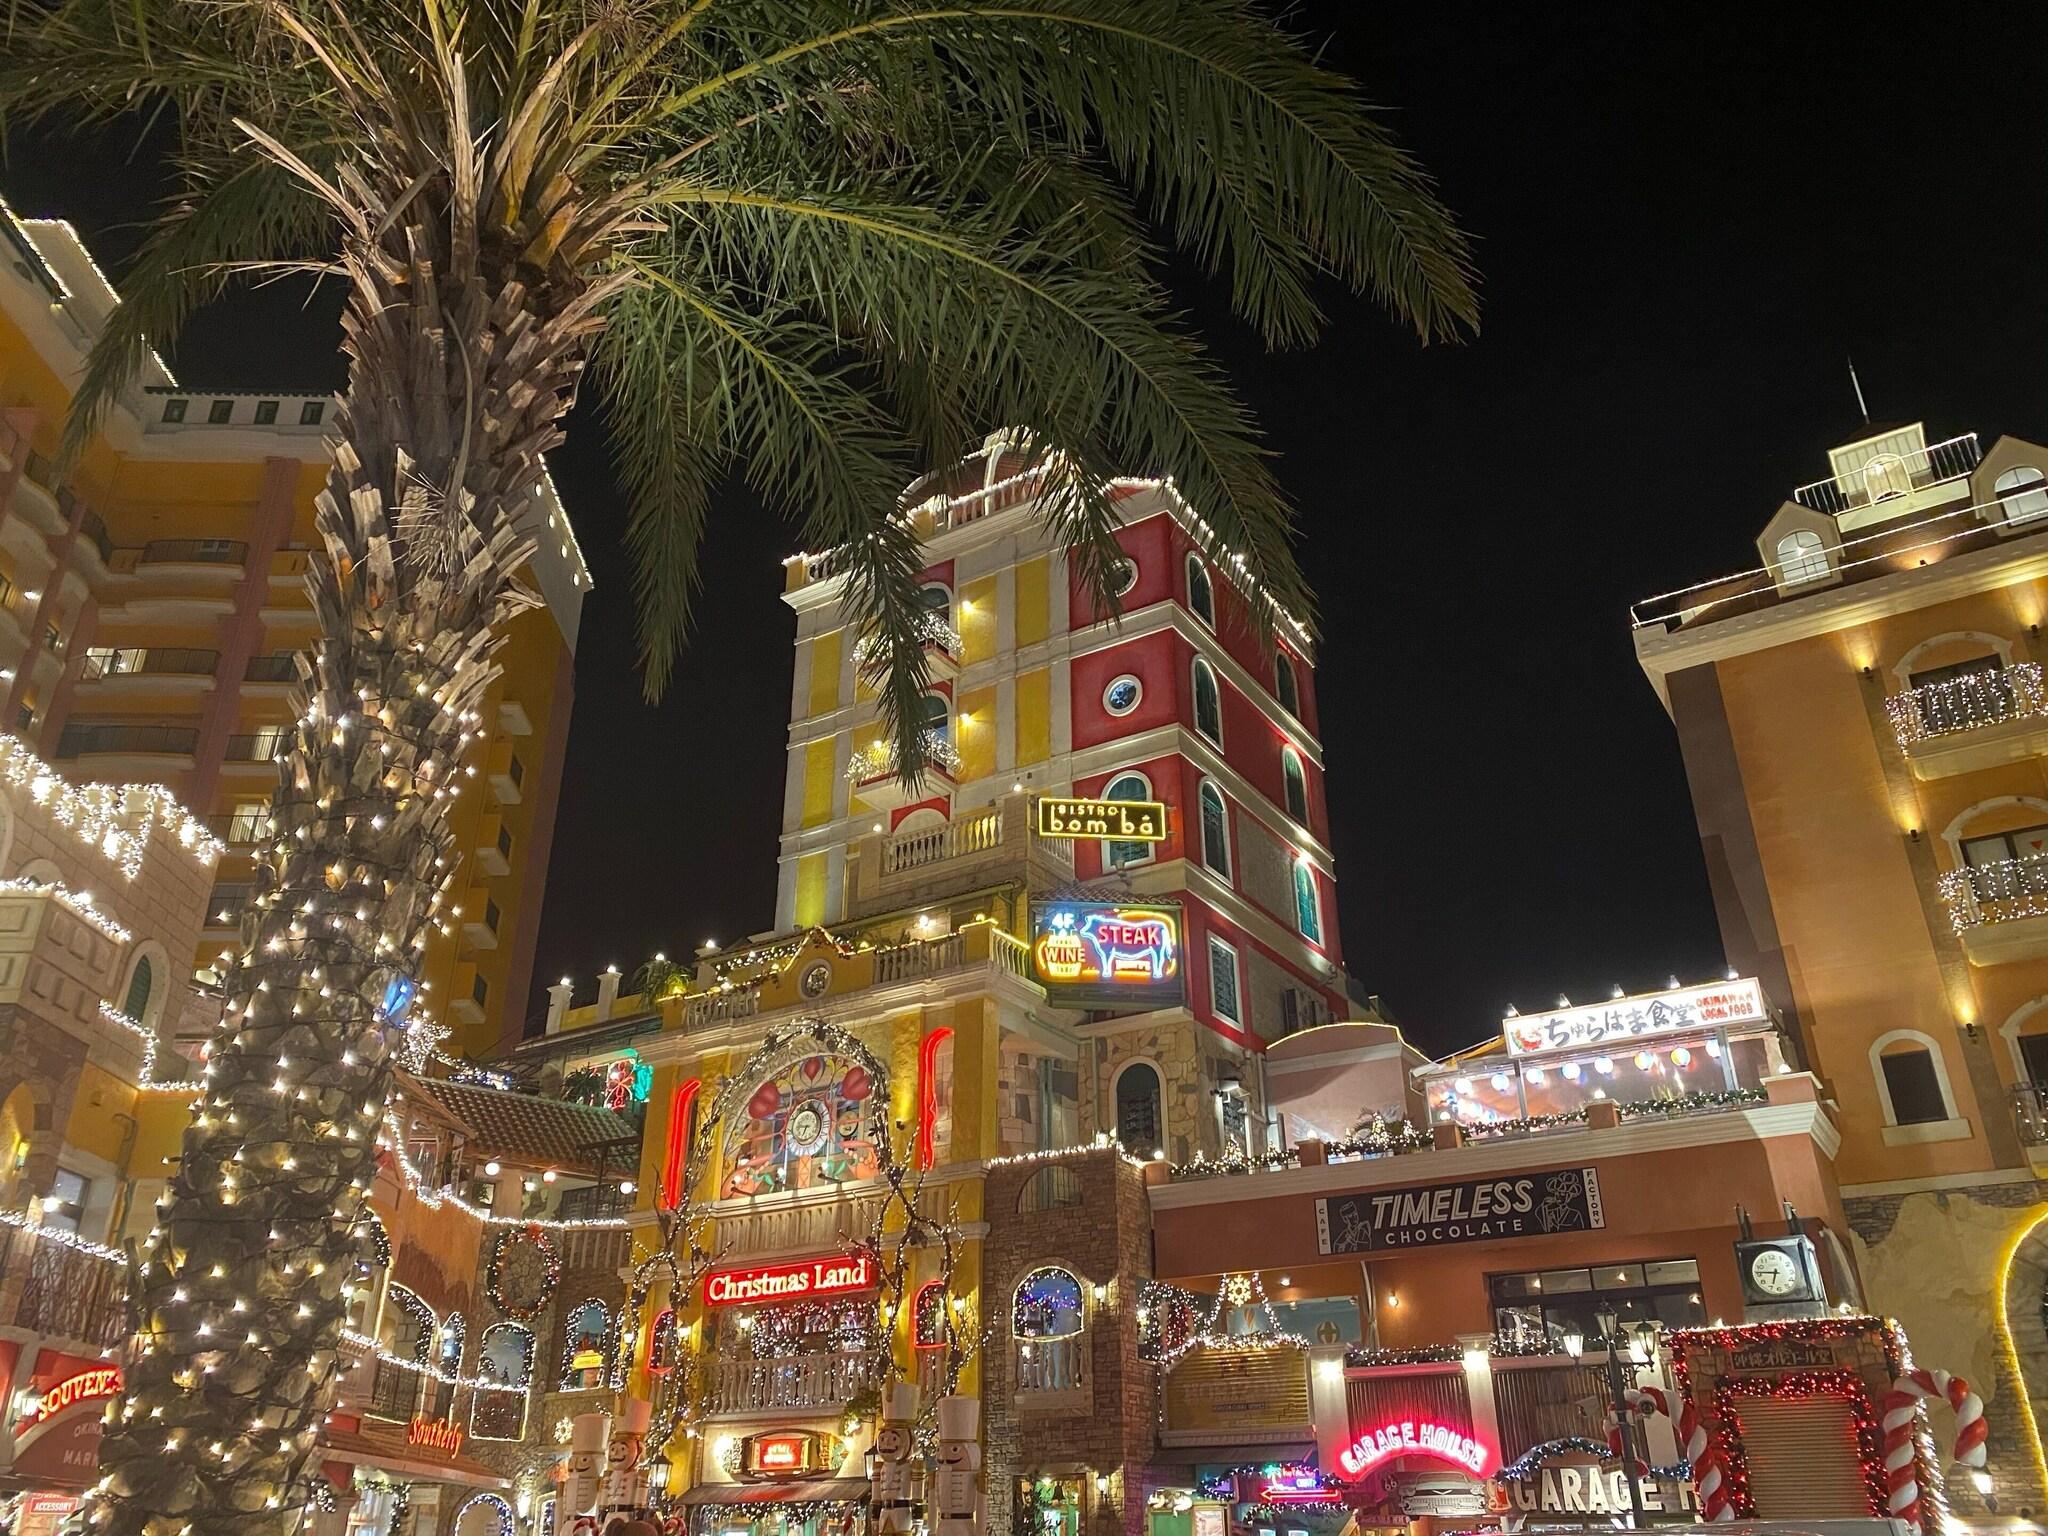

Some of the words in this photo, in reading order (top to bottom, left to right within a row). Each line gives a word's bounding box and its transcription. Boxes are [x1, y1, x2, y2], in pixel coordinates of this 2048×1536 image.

[1050, 803, 1107, 834] bom
[1058, 804, 1118, 817] BISTRO
[1052, 912, 1075, 929] 4F
[1098, 925, 1161, 945] STEAK
[1045, 947, 1086, 963] WINE
[1544, 1000, 1696, 1047] ちゅらはま食堂
[1701, 1006, 1728, 1020] LOCAL
[1729, 1002, 1753, 1016] FOOD
[1371, 1179, 1534, 1230] TIMELESS
[1586, 1170, 1599, 1226] FACTORY
[1318, 1207, 1328, 1246] CAFE
[1385, 1219, 1523, 1245] CHOCOLATE
[709, 1271, 809, 1301] Christmas
[814, 1257, 867, 1290] Land
[409, 1416, 463, 1460] Southerly
[1340, 1422, 1418, 1474] GARAGE
[1420, 1423, 1488, 1472] HOUSE
[34, 1502, 73, 1512] ACCESSORY
[1513, 1466, 1663, 1514] GARAGE
